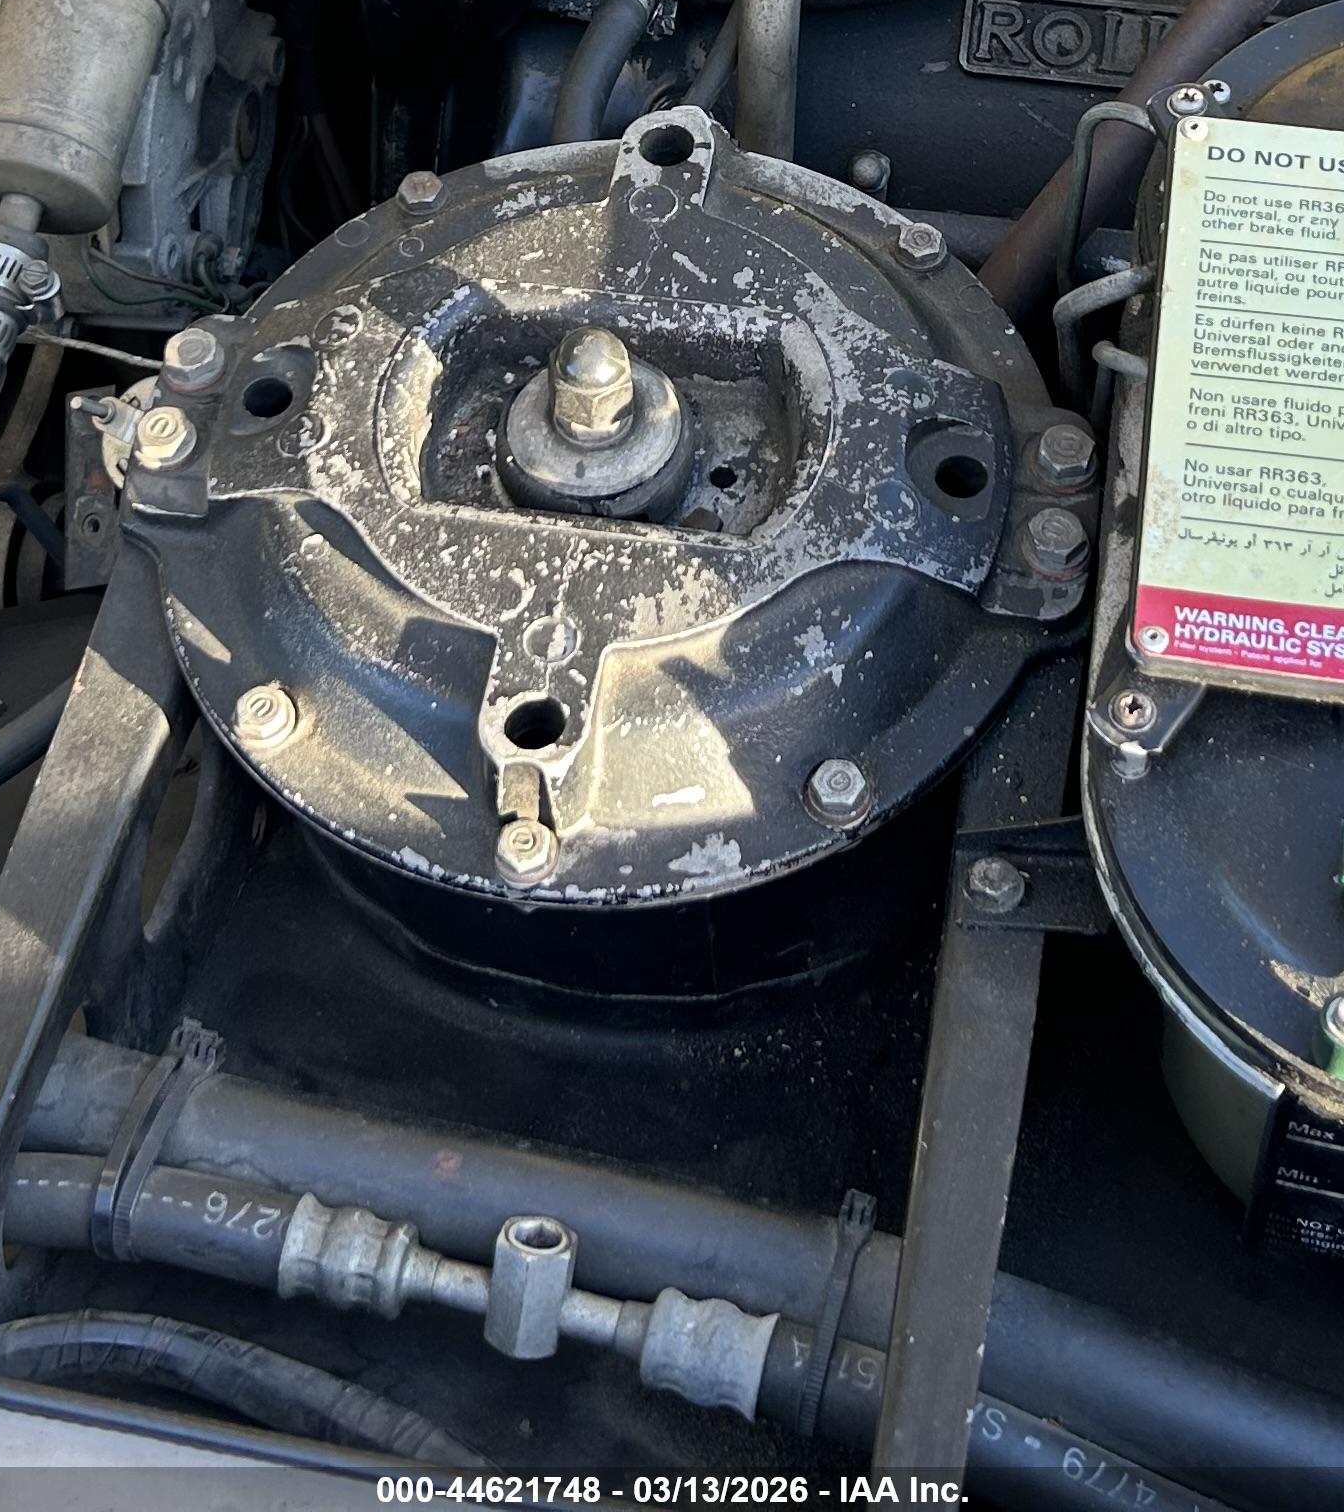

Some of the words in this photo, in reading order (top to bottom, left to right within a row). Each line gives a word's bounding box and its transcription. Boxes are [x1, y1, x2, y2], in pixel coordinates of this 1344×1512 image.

[1207, 144, 1246, 163] DO
[1254, 149, 1310, 170] NOT
[1203, 190, 1225, 203] Do
[1232, 193, 1258, 205] not
[1264, 197, 1292, 209] use
[1201, 216, 1243, 231] other
[1250, 221, 1294, 236] brake
[1288, 214, 1303, 223] or
[1199, 247, 1221, 260] Ne
[1229, 252, 1256, 266] pas
[1263, 253, 1317, 269] utiliser
[1197, 275, 1238, 289] autre
[1245, 280, 1299, 298] liquide
[1306, 288, 1343, 303] pour
[1285, 272, 1305, 283] ou
[1312, 274, 1343, 286] tout
[1195, 313, 1214, 326] Es
[1282, 322, 1325, 337] keine
[1193, 327, 1270, 347] Universal
[1277, 336, 1314, 351] oder
[1191, 357, 1278, 377] verwendet
[1188, 403, 1225, 418] freni
[1189, 387, 1224, 402] Non
[1231, 394, 1276, 407] usare
[1283, 397, 1331, 413] fluido
[1186, 420, 1196, 430] o
[1203, 420, 1218, 433] di
[1225, 422, 1262, 437] altro
[1184, 458, 1208, 473] No
[1215, 463, 1252, 477] usar
[1183, 474, 1262, 494] Universal
[1269, 486, 1280, 496] o
[1181, 491, 1216, 505] otro
[1288, 504, 1324, 519] para
[1173, 606, 1288, 635] WARNING.
[1174, 622, 1301, 654] HYDRAULIC
[1288, 1121, 1335, 1142] Max
[1277, 1166, 1319, 1185] Min
